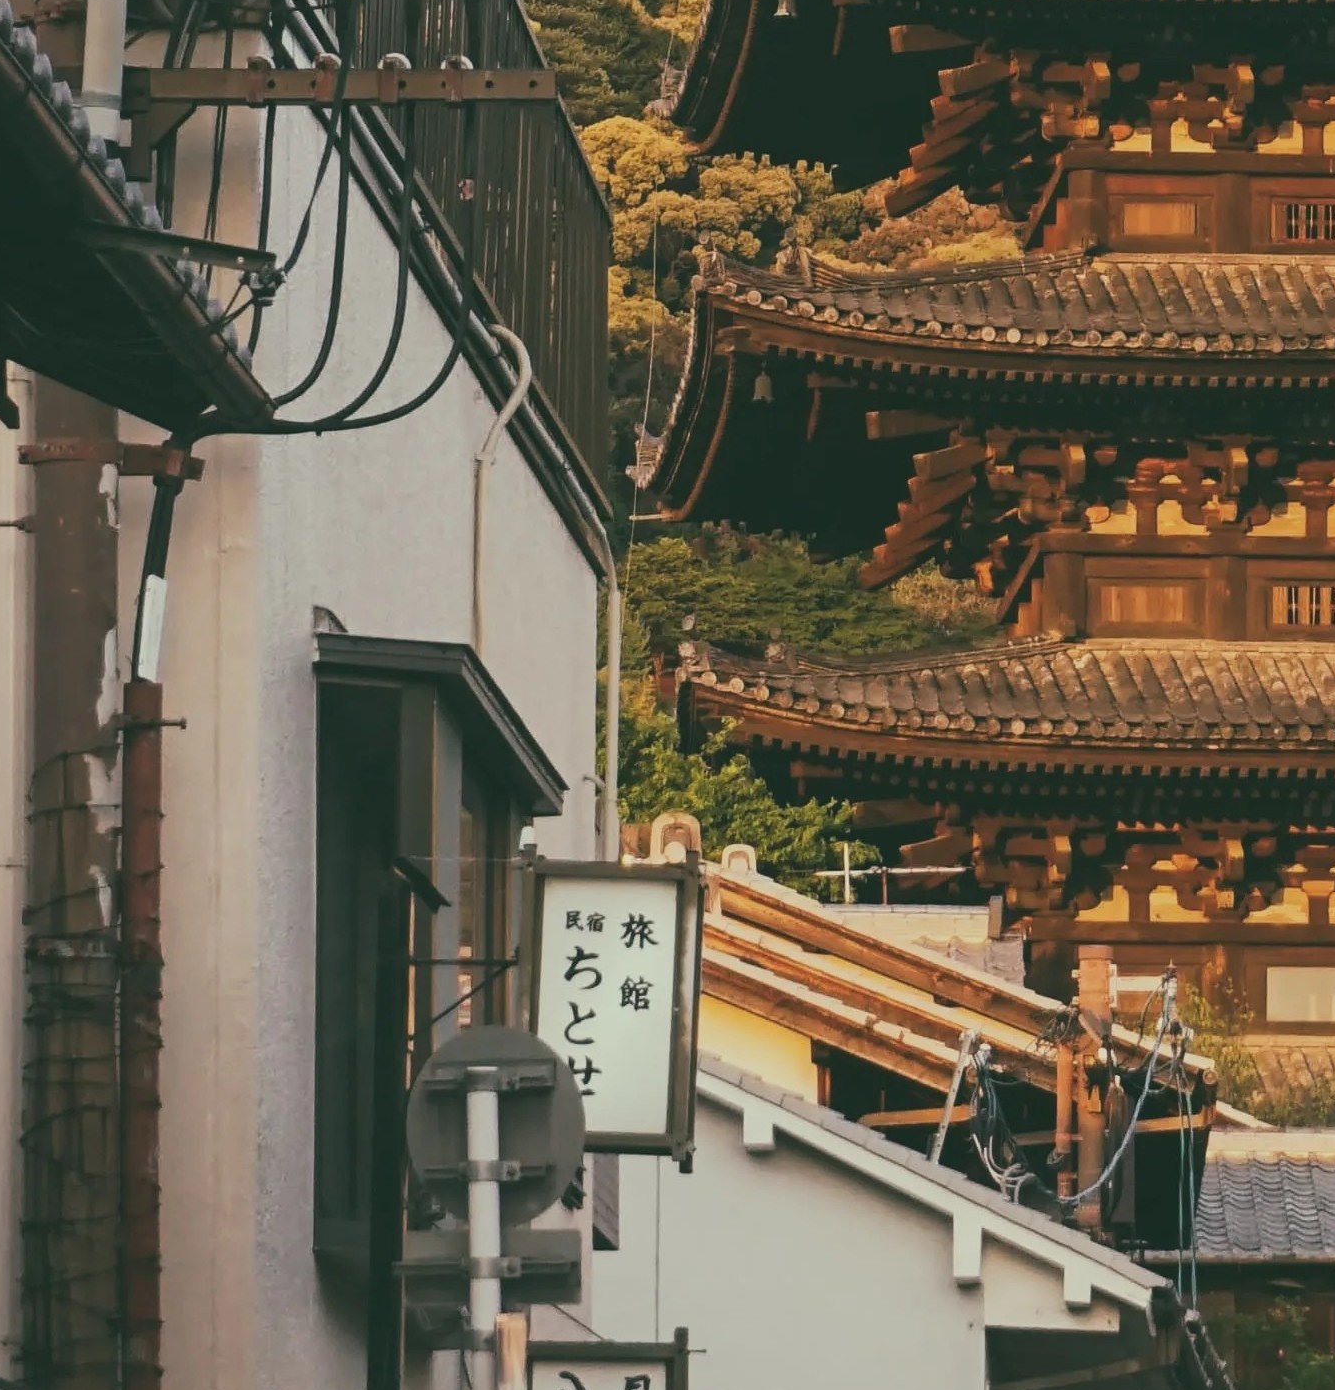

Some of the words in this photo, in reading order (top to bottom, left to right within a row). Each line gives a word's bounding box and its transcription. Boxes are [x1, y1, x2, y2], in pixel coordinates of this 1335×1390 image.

[565, 910, 606, 933] 民宿
[619, 913, 659, 1012] 旅館
[564, 945, 602, 1096] ちとせ
